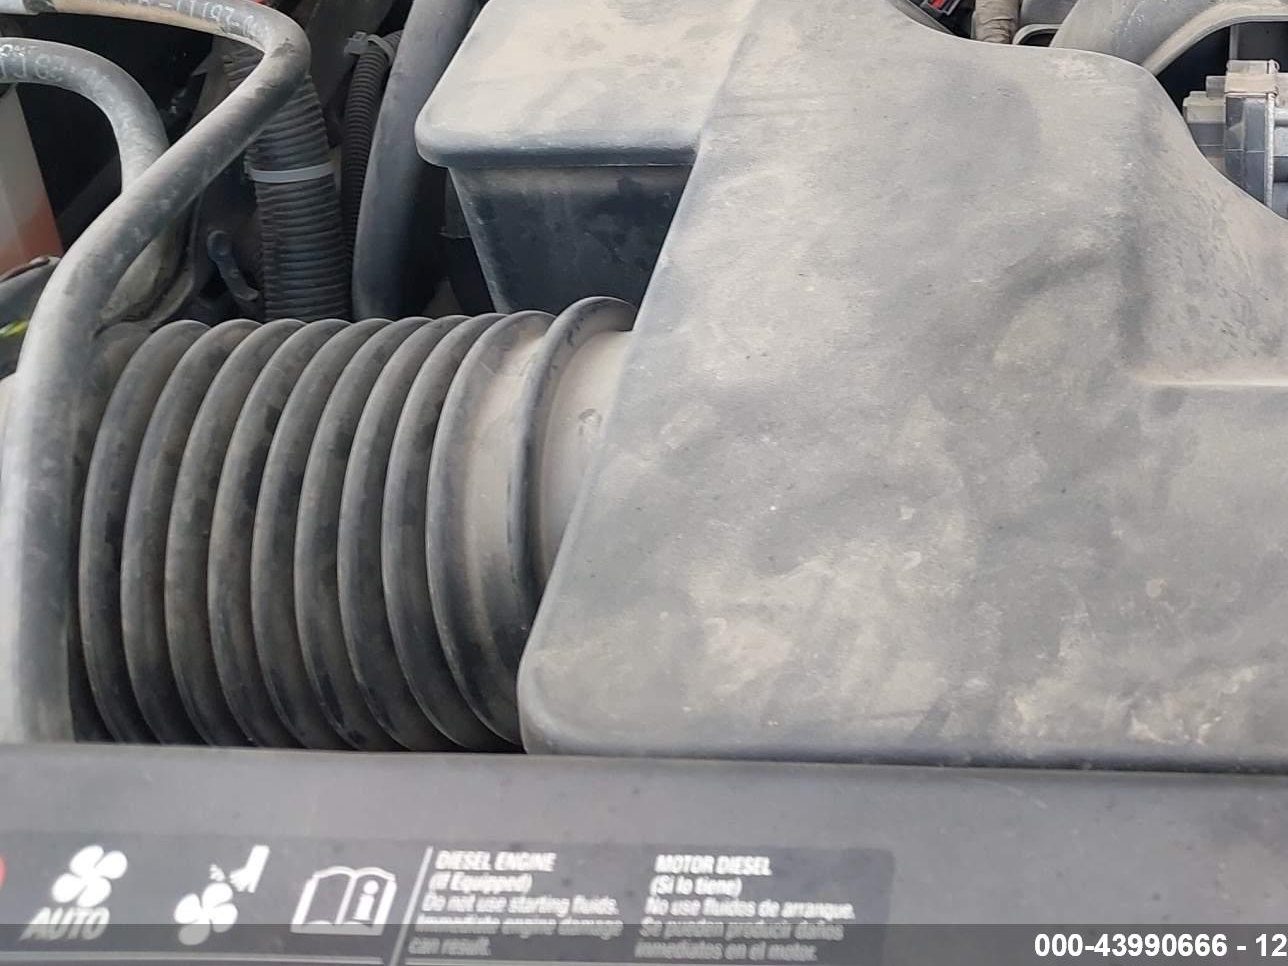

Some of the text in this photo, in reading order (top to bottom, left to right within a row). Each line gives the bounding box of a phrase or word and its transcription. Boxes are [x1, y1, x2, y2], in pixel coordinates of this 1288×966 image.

[435, 850, 557, 872] DIESEL ENGINE
[654, 854, 772, 876] MOTOR DIESEL
[18, 907, 111, 941] AUTO
